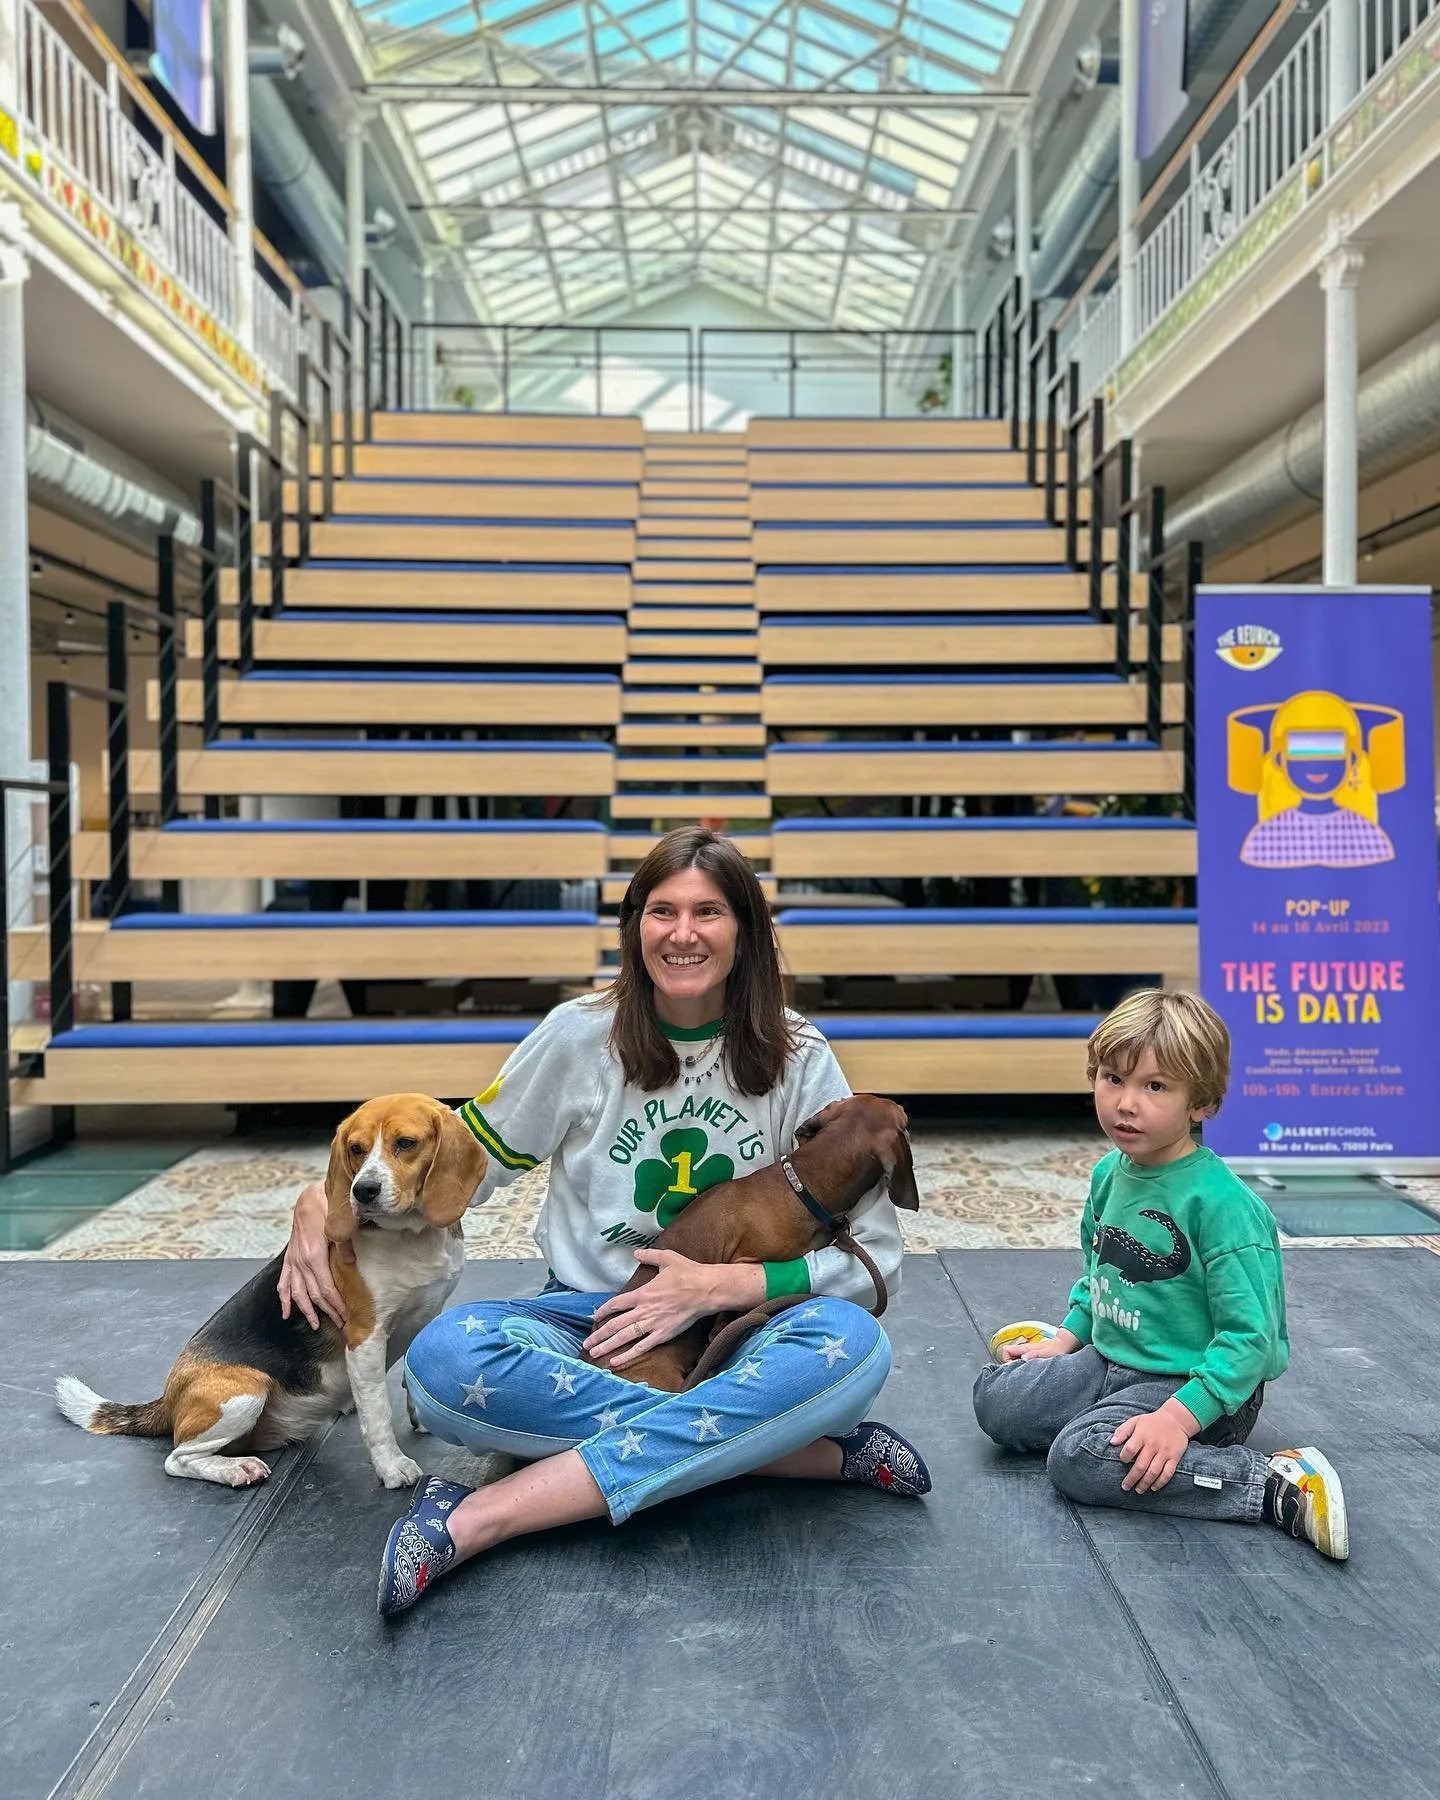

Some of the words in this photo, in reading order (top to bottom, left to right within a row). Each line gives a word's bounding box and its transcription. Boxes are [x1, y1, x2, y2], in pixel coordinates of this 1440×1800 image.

[1216, 628, 1235, 647] THE
[1237, 624, 1280, 646] REUNION
[1285, 899, 1350, 917] POP-UP
[1251, 921, 1267, 934] 14
[1271, 924, 1288, 934] au
[1315, 920, 1349, 933] Avril
[1221, 961, 1277, 993] THE
[1291, 960, 1405, 993] FUTURE
[1256, 993, 1285, 1024] IS
[1298, 993, 1381, 1024] DATA
[1365, 1083, 1405, 1096] Libre
[609, 1118, 645, 1165] OUR
[643, 1095, 748, 1134] PLANET
[668, 1151, 697, 1194] 1
